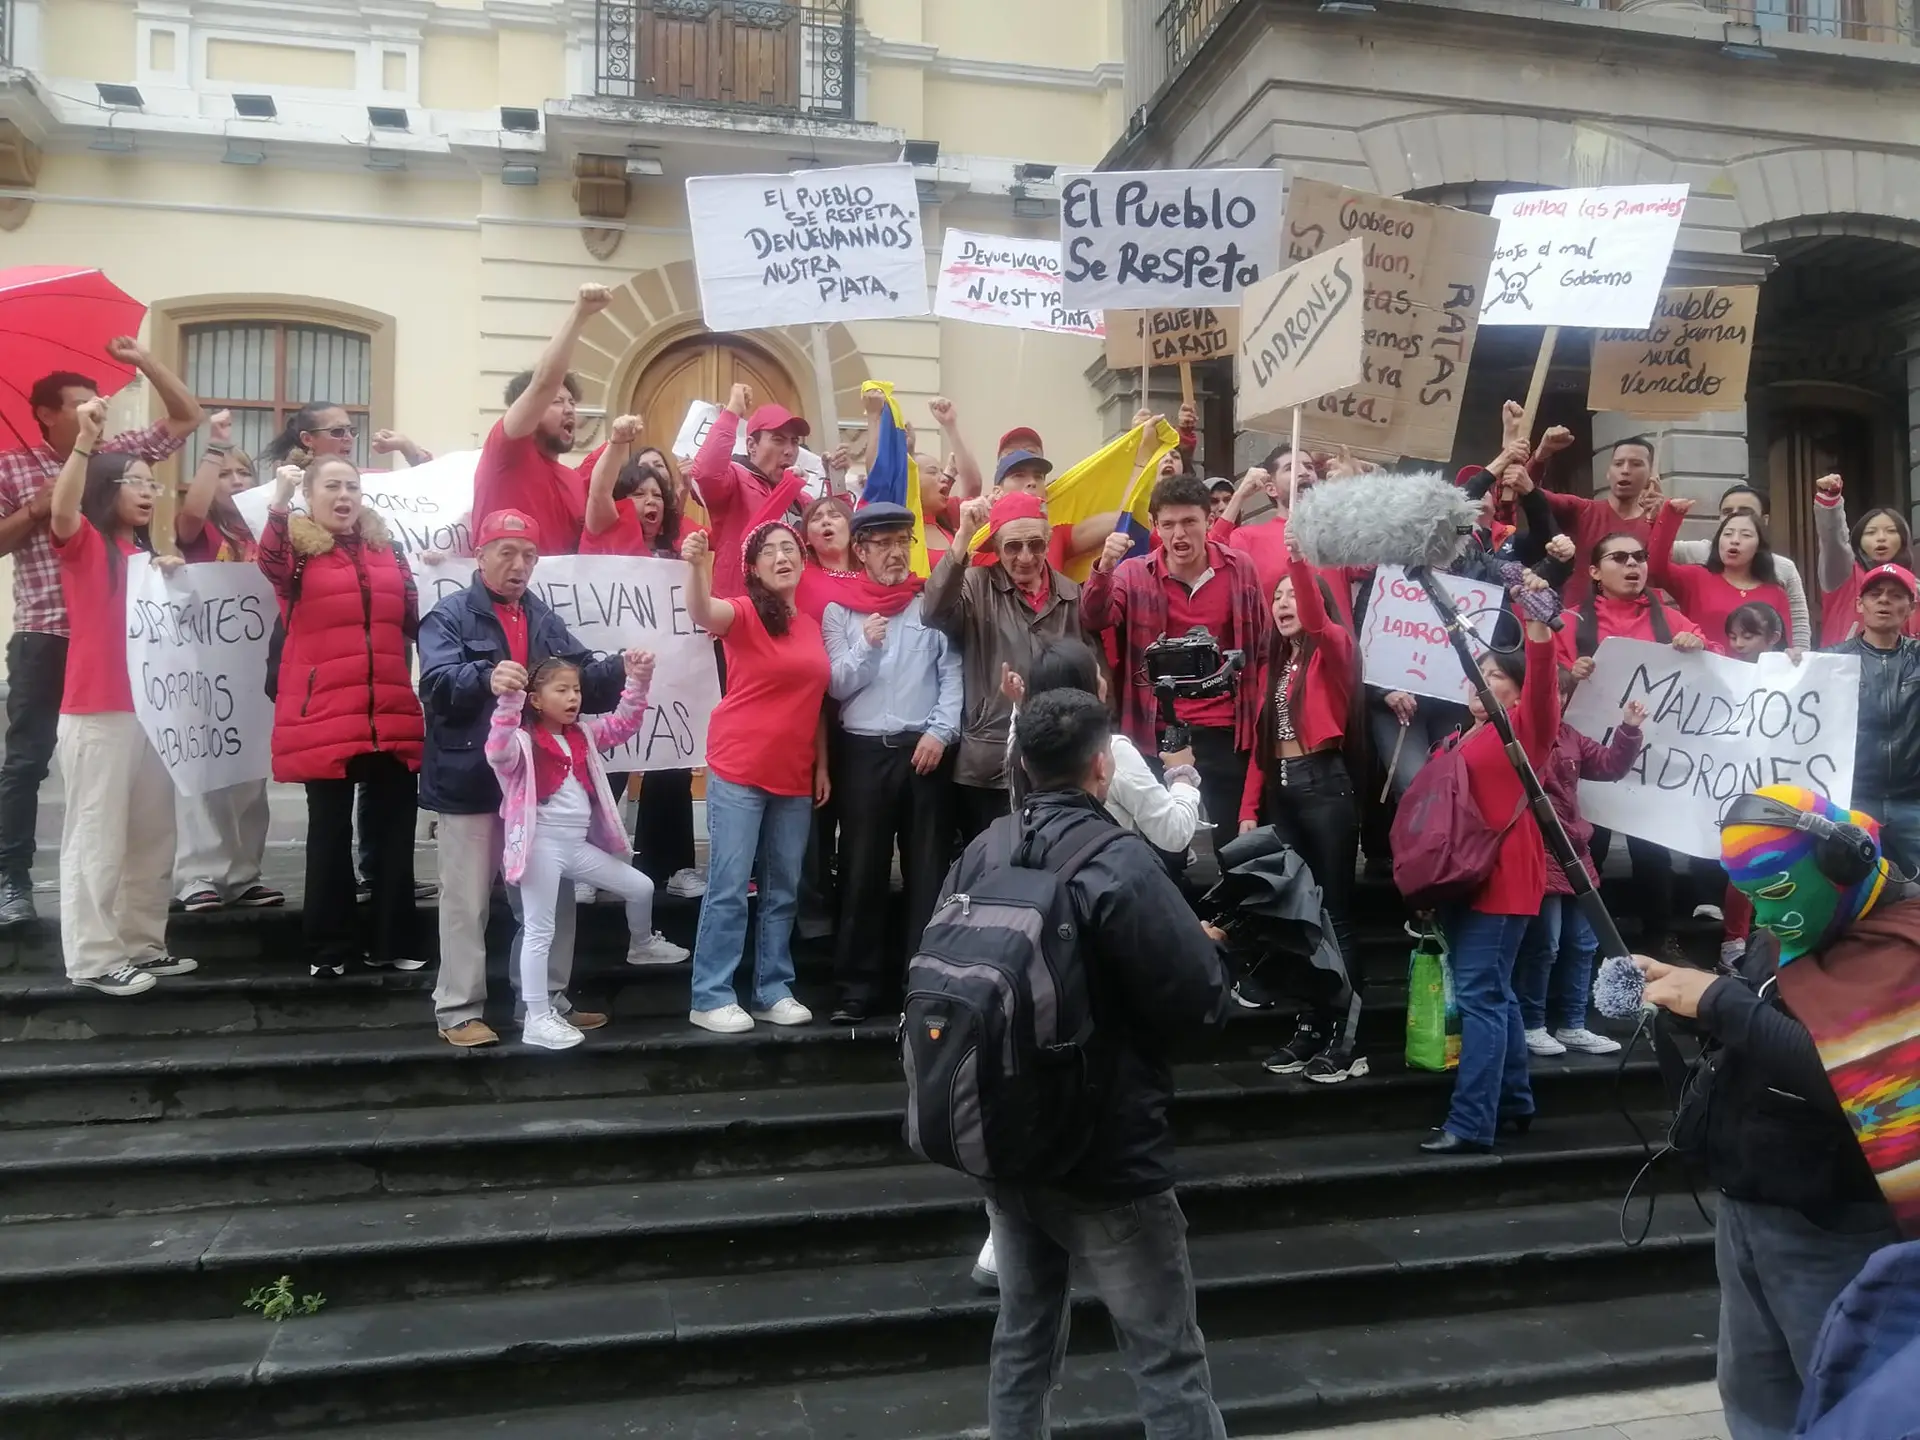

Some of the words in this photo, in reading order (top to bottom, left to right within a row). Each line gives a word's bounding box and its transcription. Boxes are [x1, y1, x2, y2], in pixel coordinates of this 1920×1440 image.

[796, 184, 873, 209] PUEBLO
[1062, 178, 1102, 228] El
[1115, 180, 1256, 229] Pueblo
[1578, 198, 1608, 219] las
[785, 210, 818, 227] SE
[826, 203, 916, 224] RESPETA.
[744, 219, 912, 260] DEVUELVANNOS
[1538, 240, 1552, 256] el
[1558, 237, 1597, 259] mal
[763, 254, 841, 285] NUSTRA
[1064, 236, 1109, 282] Se
[1364, 243, 1415, 280] dron,
[1363, 287, 1418, 318] tas.
[1252, 257, 1353, 388] LADRONES
[1152, 328, 1228, 359] CARAJO
[1420, 283, 1475, 406] RATAS
[1301, 392, 1388, 424] lata.
[1202, 675, 1223, 689] RONIN
[1619, 663, 1821, 745] MALDITOS
